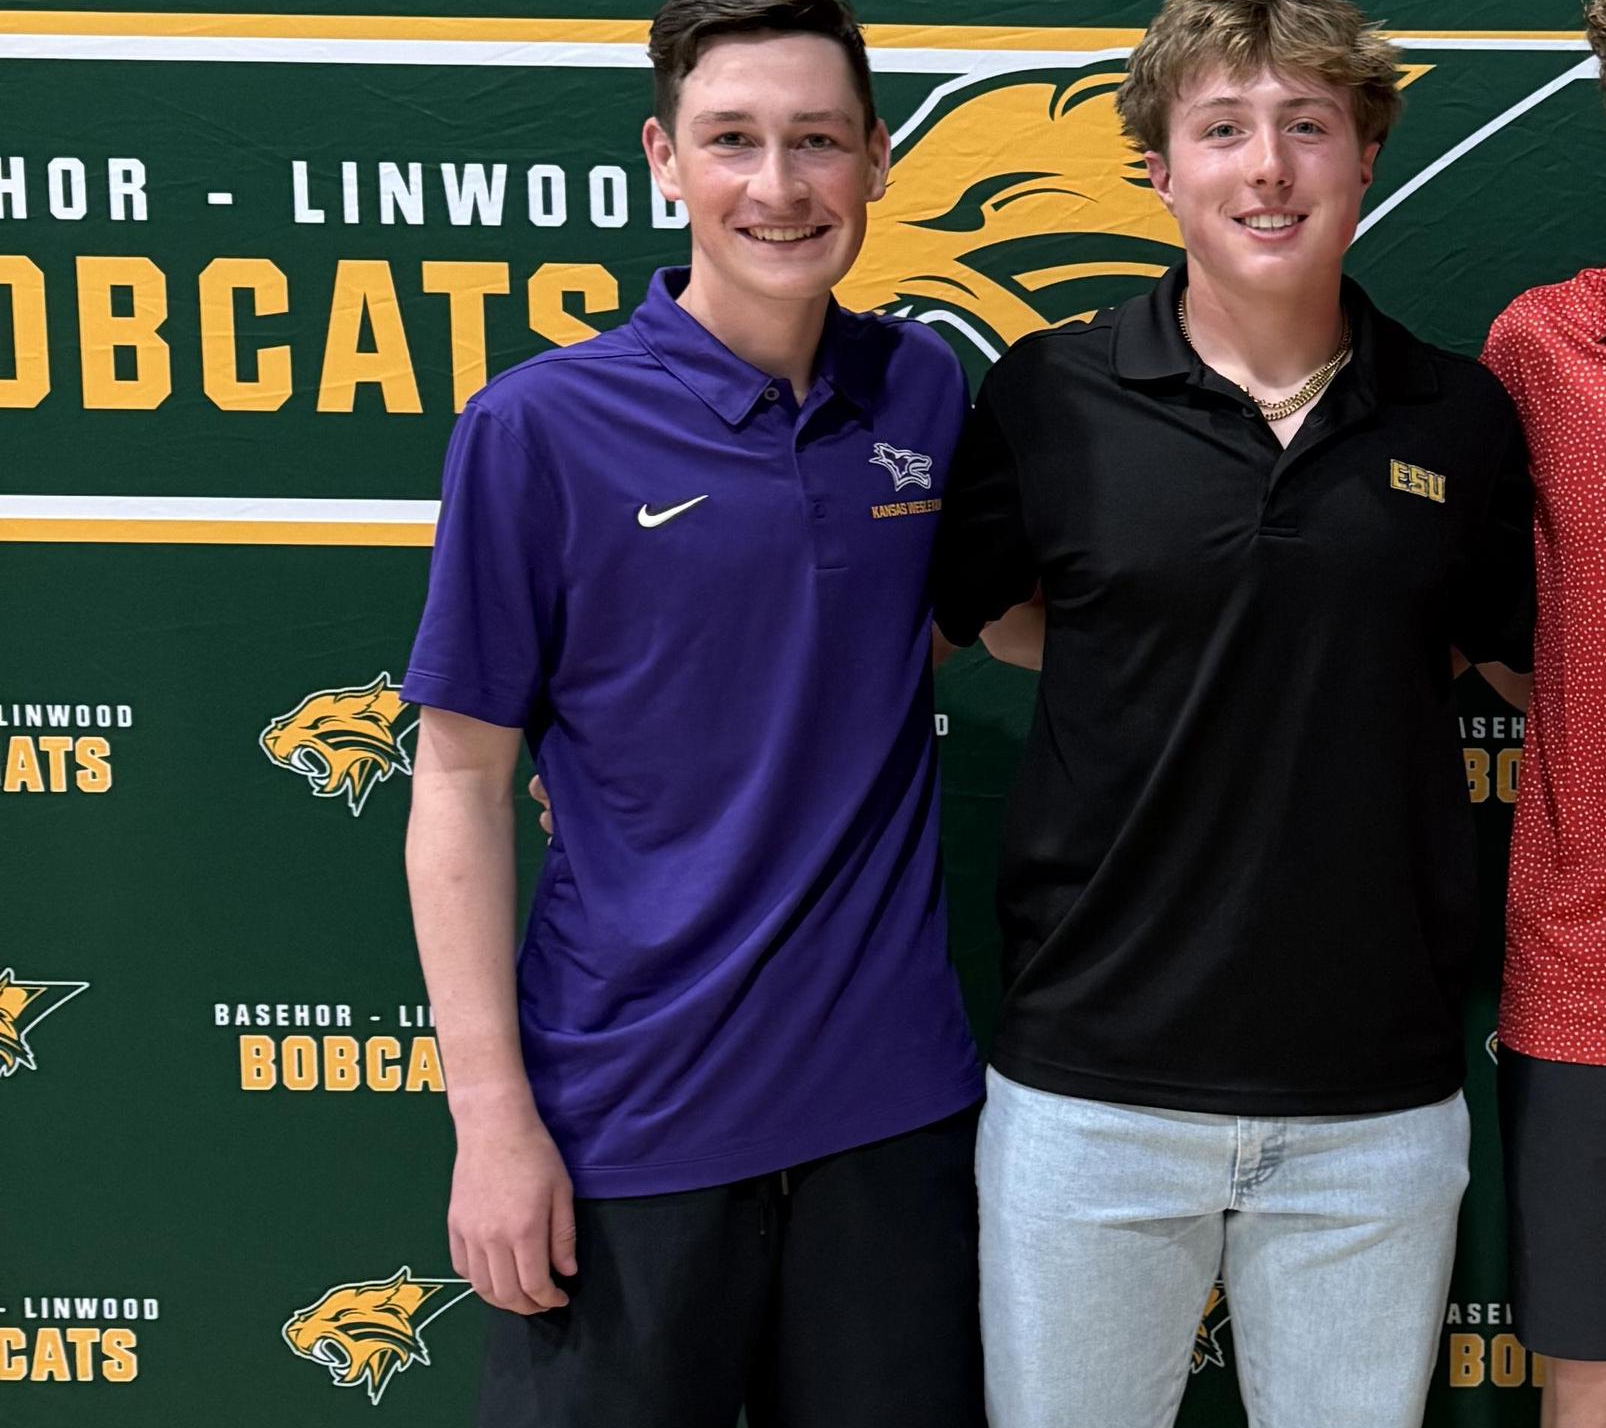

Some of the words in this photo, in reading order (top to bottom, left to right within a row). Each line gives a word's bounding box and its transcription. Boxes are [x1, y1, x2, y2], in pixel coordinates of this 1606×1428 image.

[1390, 458, 1446, 503] ESU
[871, 502, 908, 519] KANSAS
[0, 704, 134, 728] LINWOOD
[214, 1003, 353, 1027] BASEHOR
[24, 1297, 160, 1320] LINWOOD
